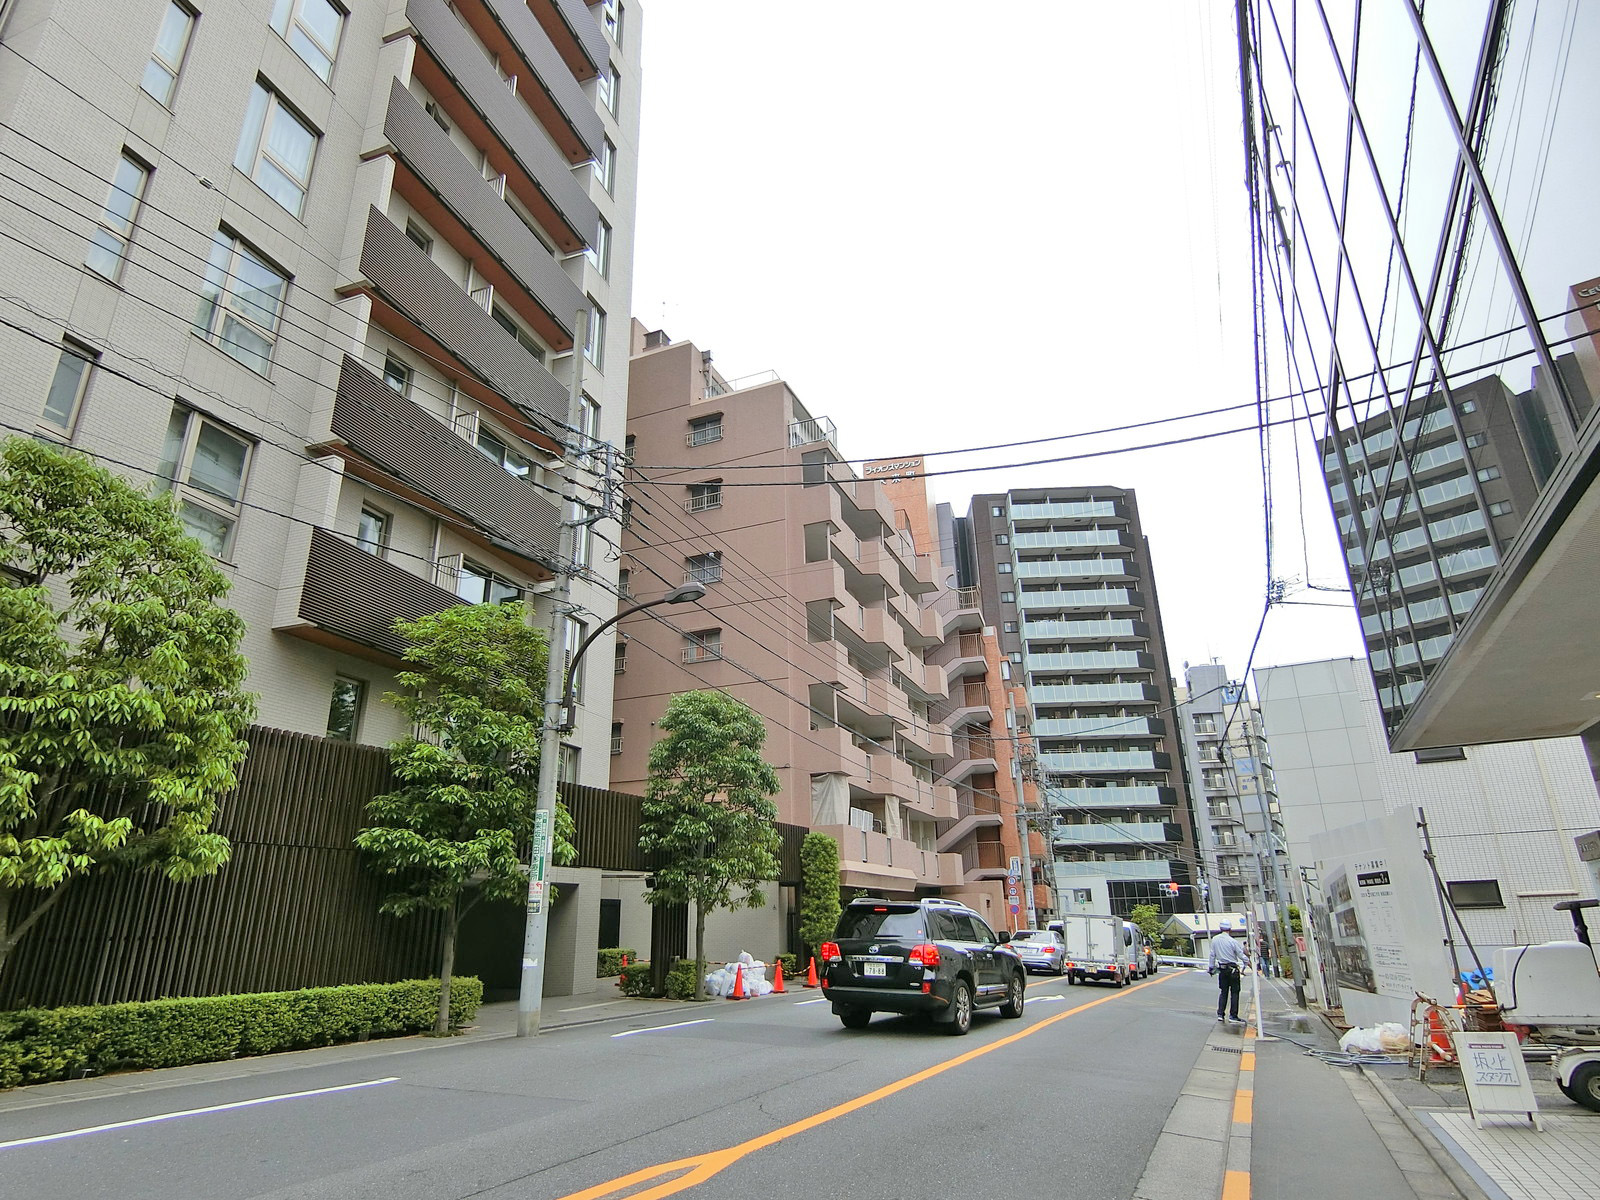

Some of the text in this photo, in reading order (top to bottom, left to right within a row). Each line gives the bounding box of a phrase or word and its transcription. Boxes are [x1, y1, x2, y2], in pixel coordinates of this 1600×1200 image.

[865, 459, 921, 475] ライオンズマンション
